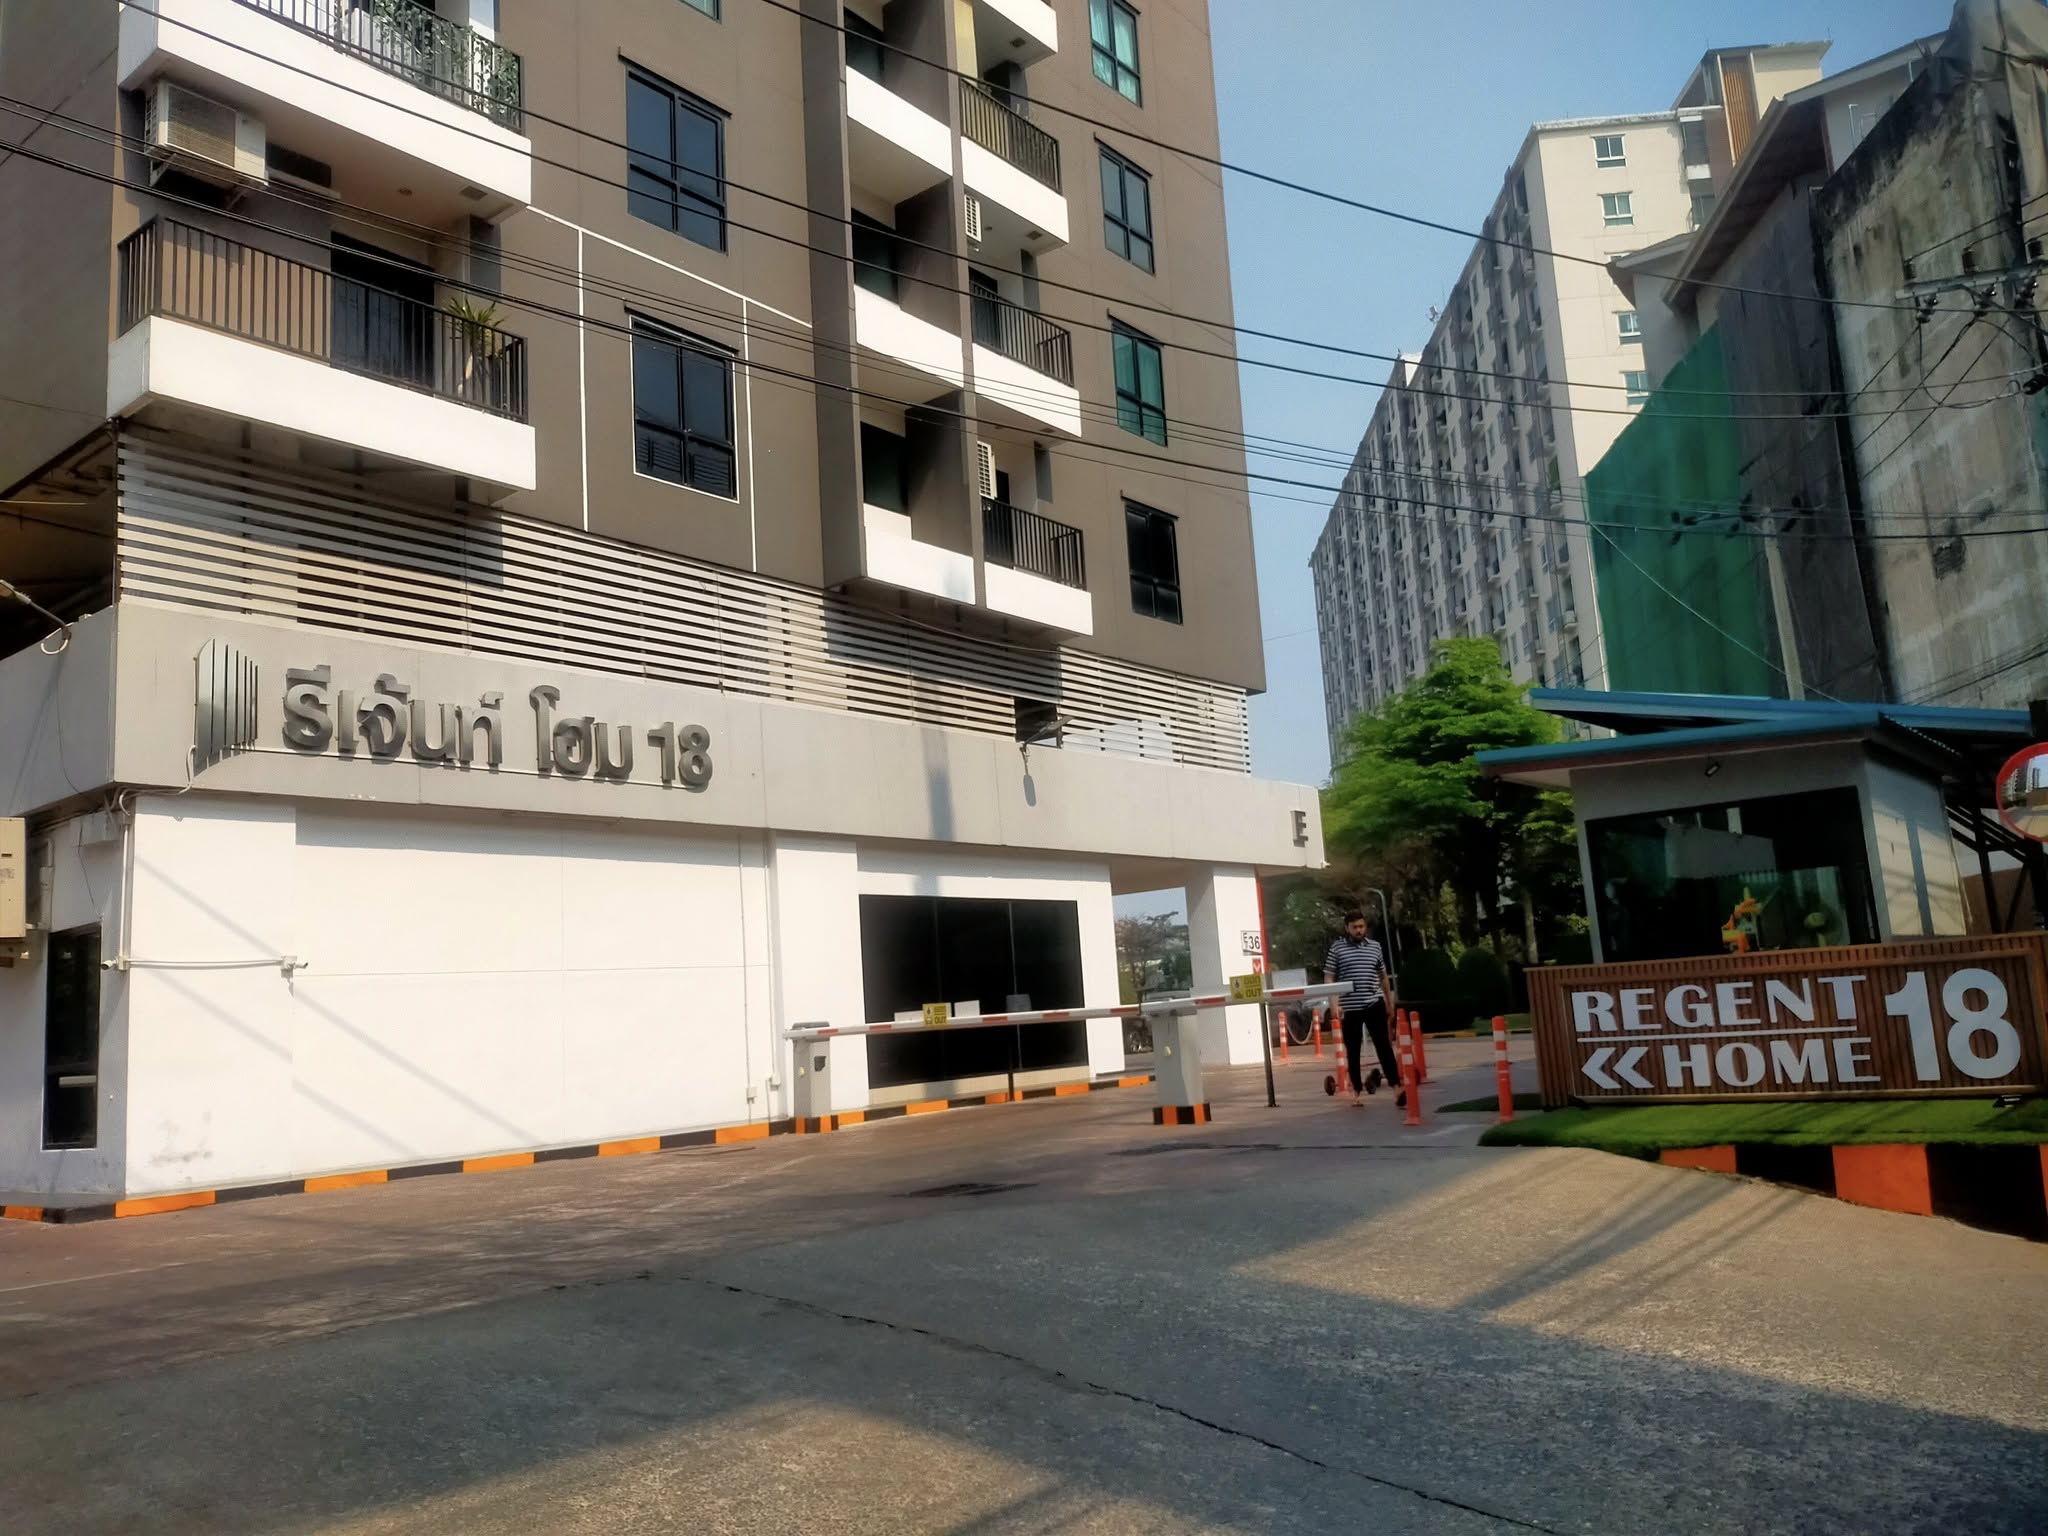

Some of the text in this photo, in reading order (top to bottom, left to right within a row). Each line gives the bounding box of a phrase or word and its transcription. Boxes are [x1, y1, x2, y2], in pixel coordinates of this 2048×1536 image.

[529, 685, 634, 780] โฮม
[647, 722, 713, 789] 18
[1290, 810, 1309, 845] E
[1571, 975, 1867, 1033] REGENT
[1885, 968, 2021, 1081] 18
[1662, 1037, 1881, 1088] HOME
